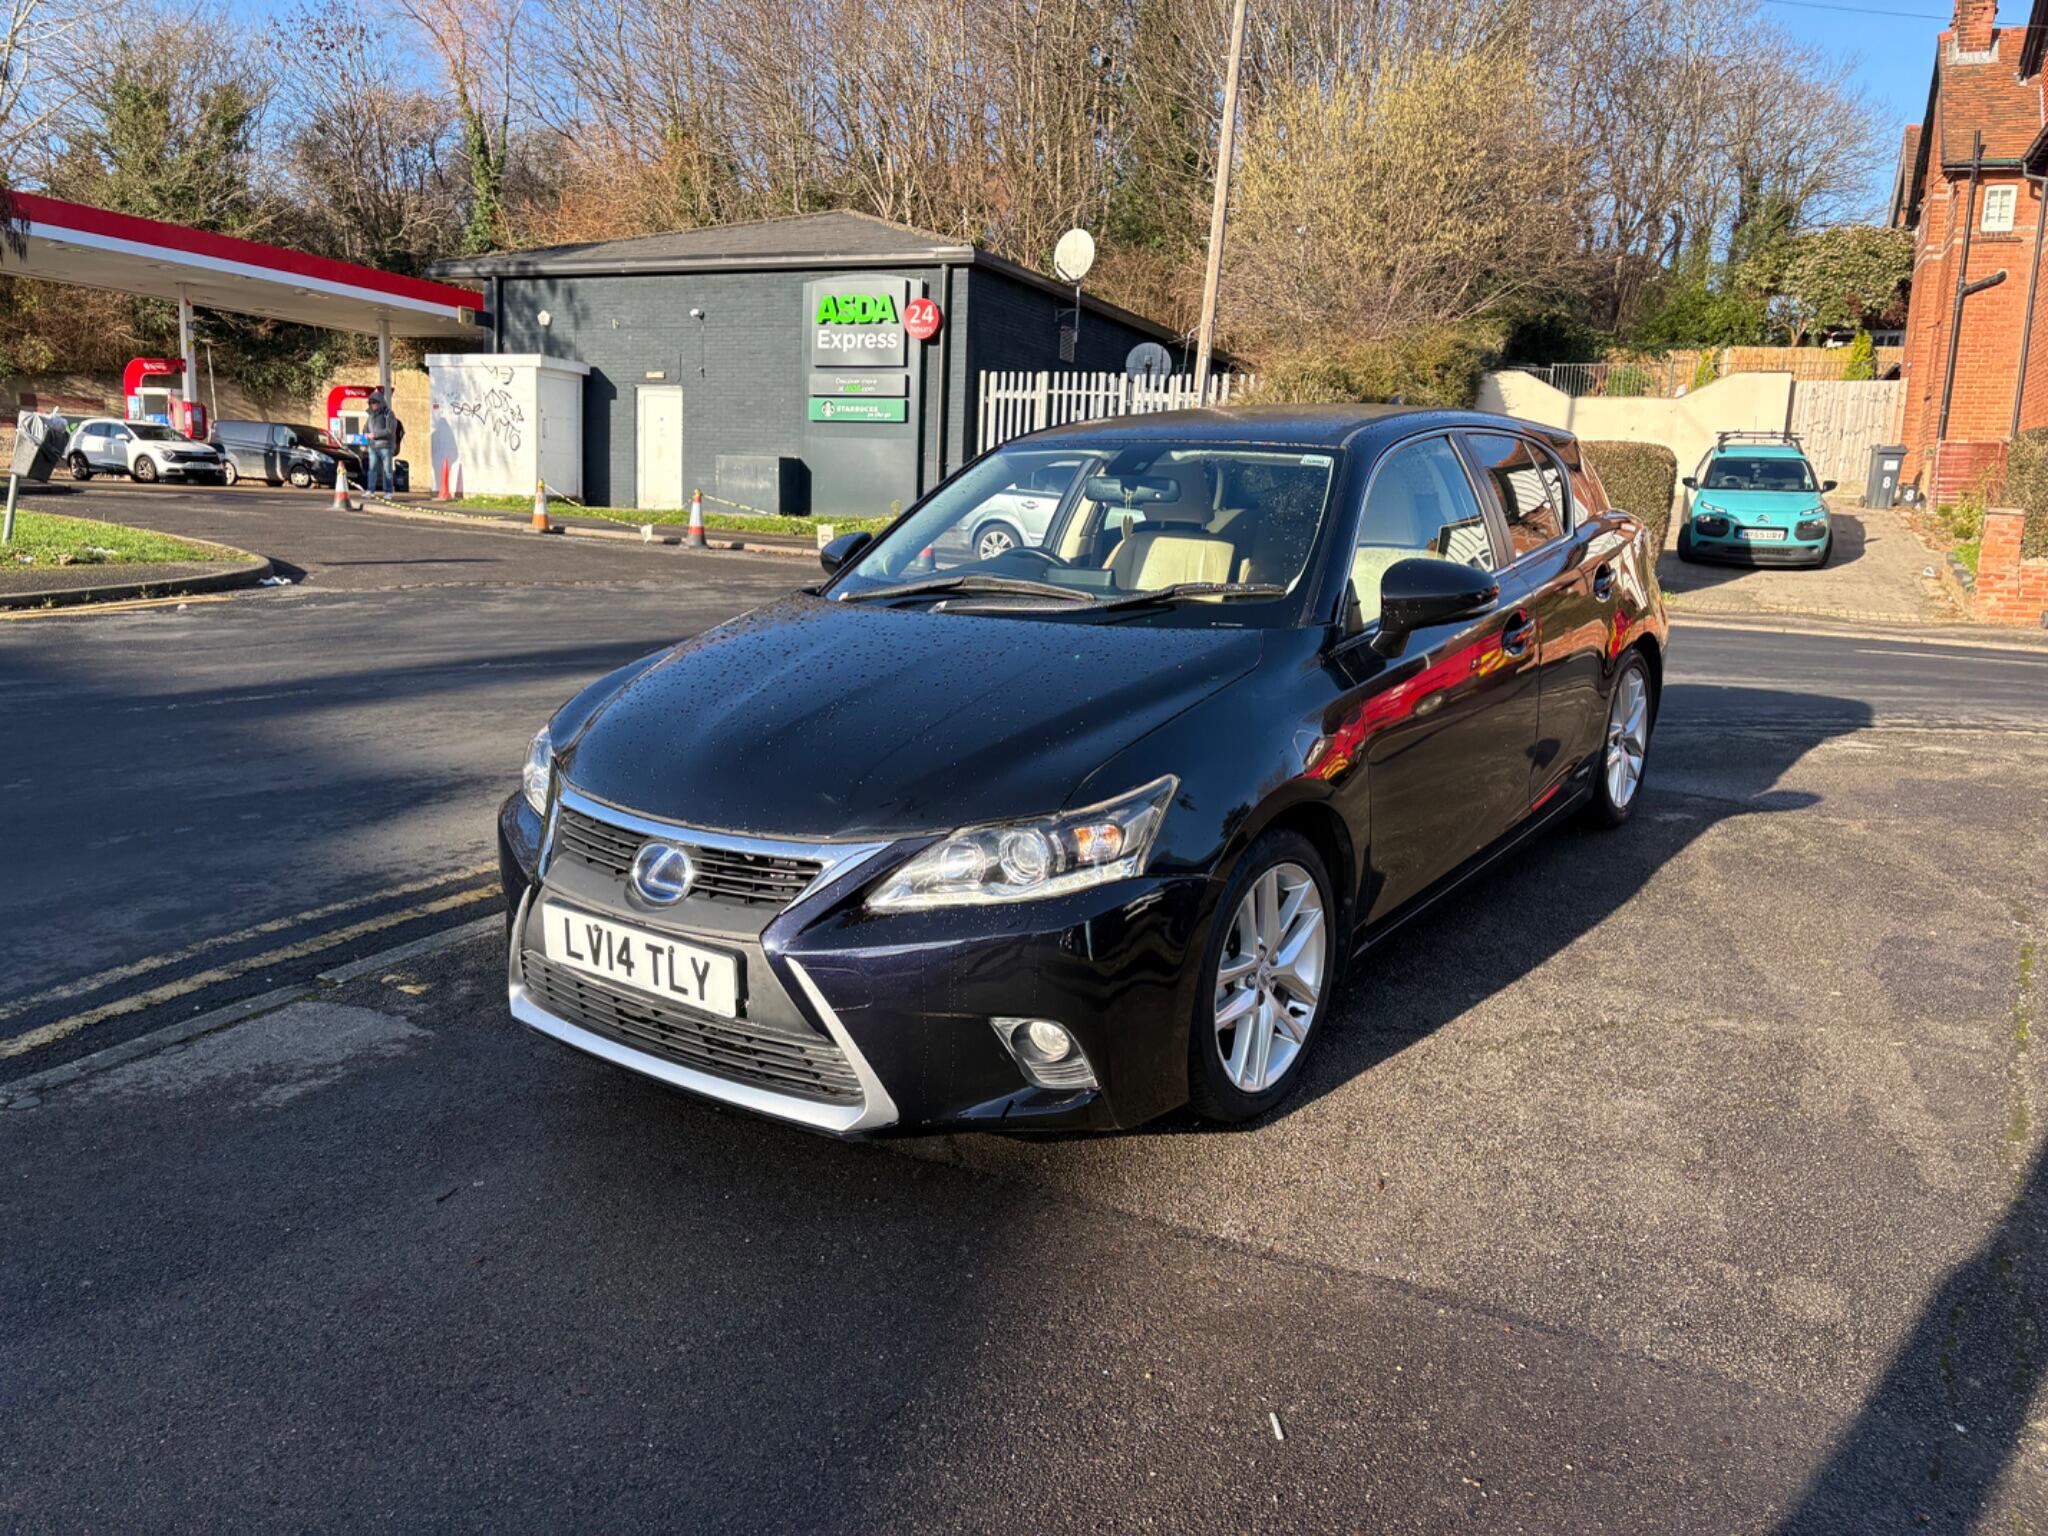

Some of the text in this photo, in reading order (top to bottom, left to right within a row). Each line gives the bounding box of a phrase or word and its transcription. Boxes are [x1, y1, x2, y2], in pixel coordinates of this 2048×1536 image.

[816, 293, 897, 324] ASDA
[910, 305, 935, 323] 24
[818, 329, 897, 352] Express
[1882, 476, 1891, 489] 8
[564, 917, 710, 1001] LV14 TLY
